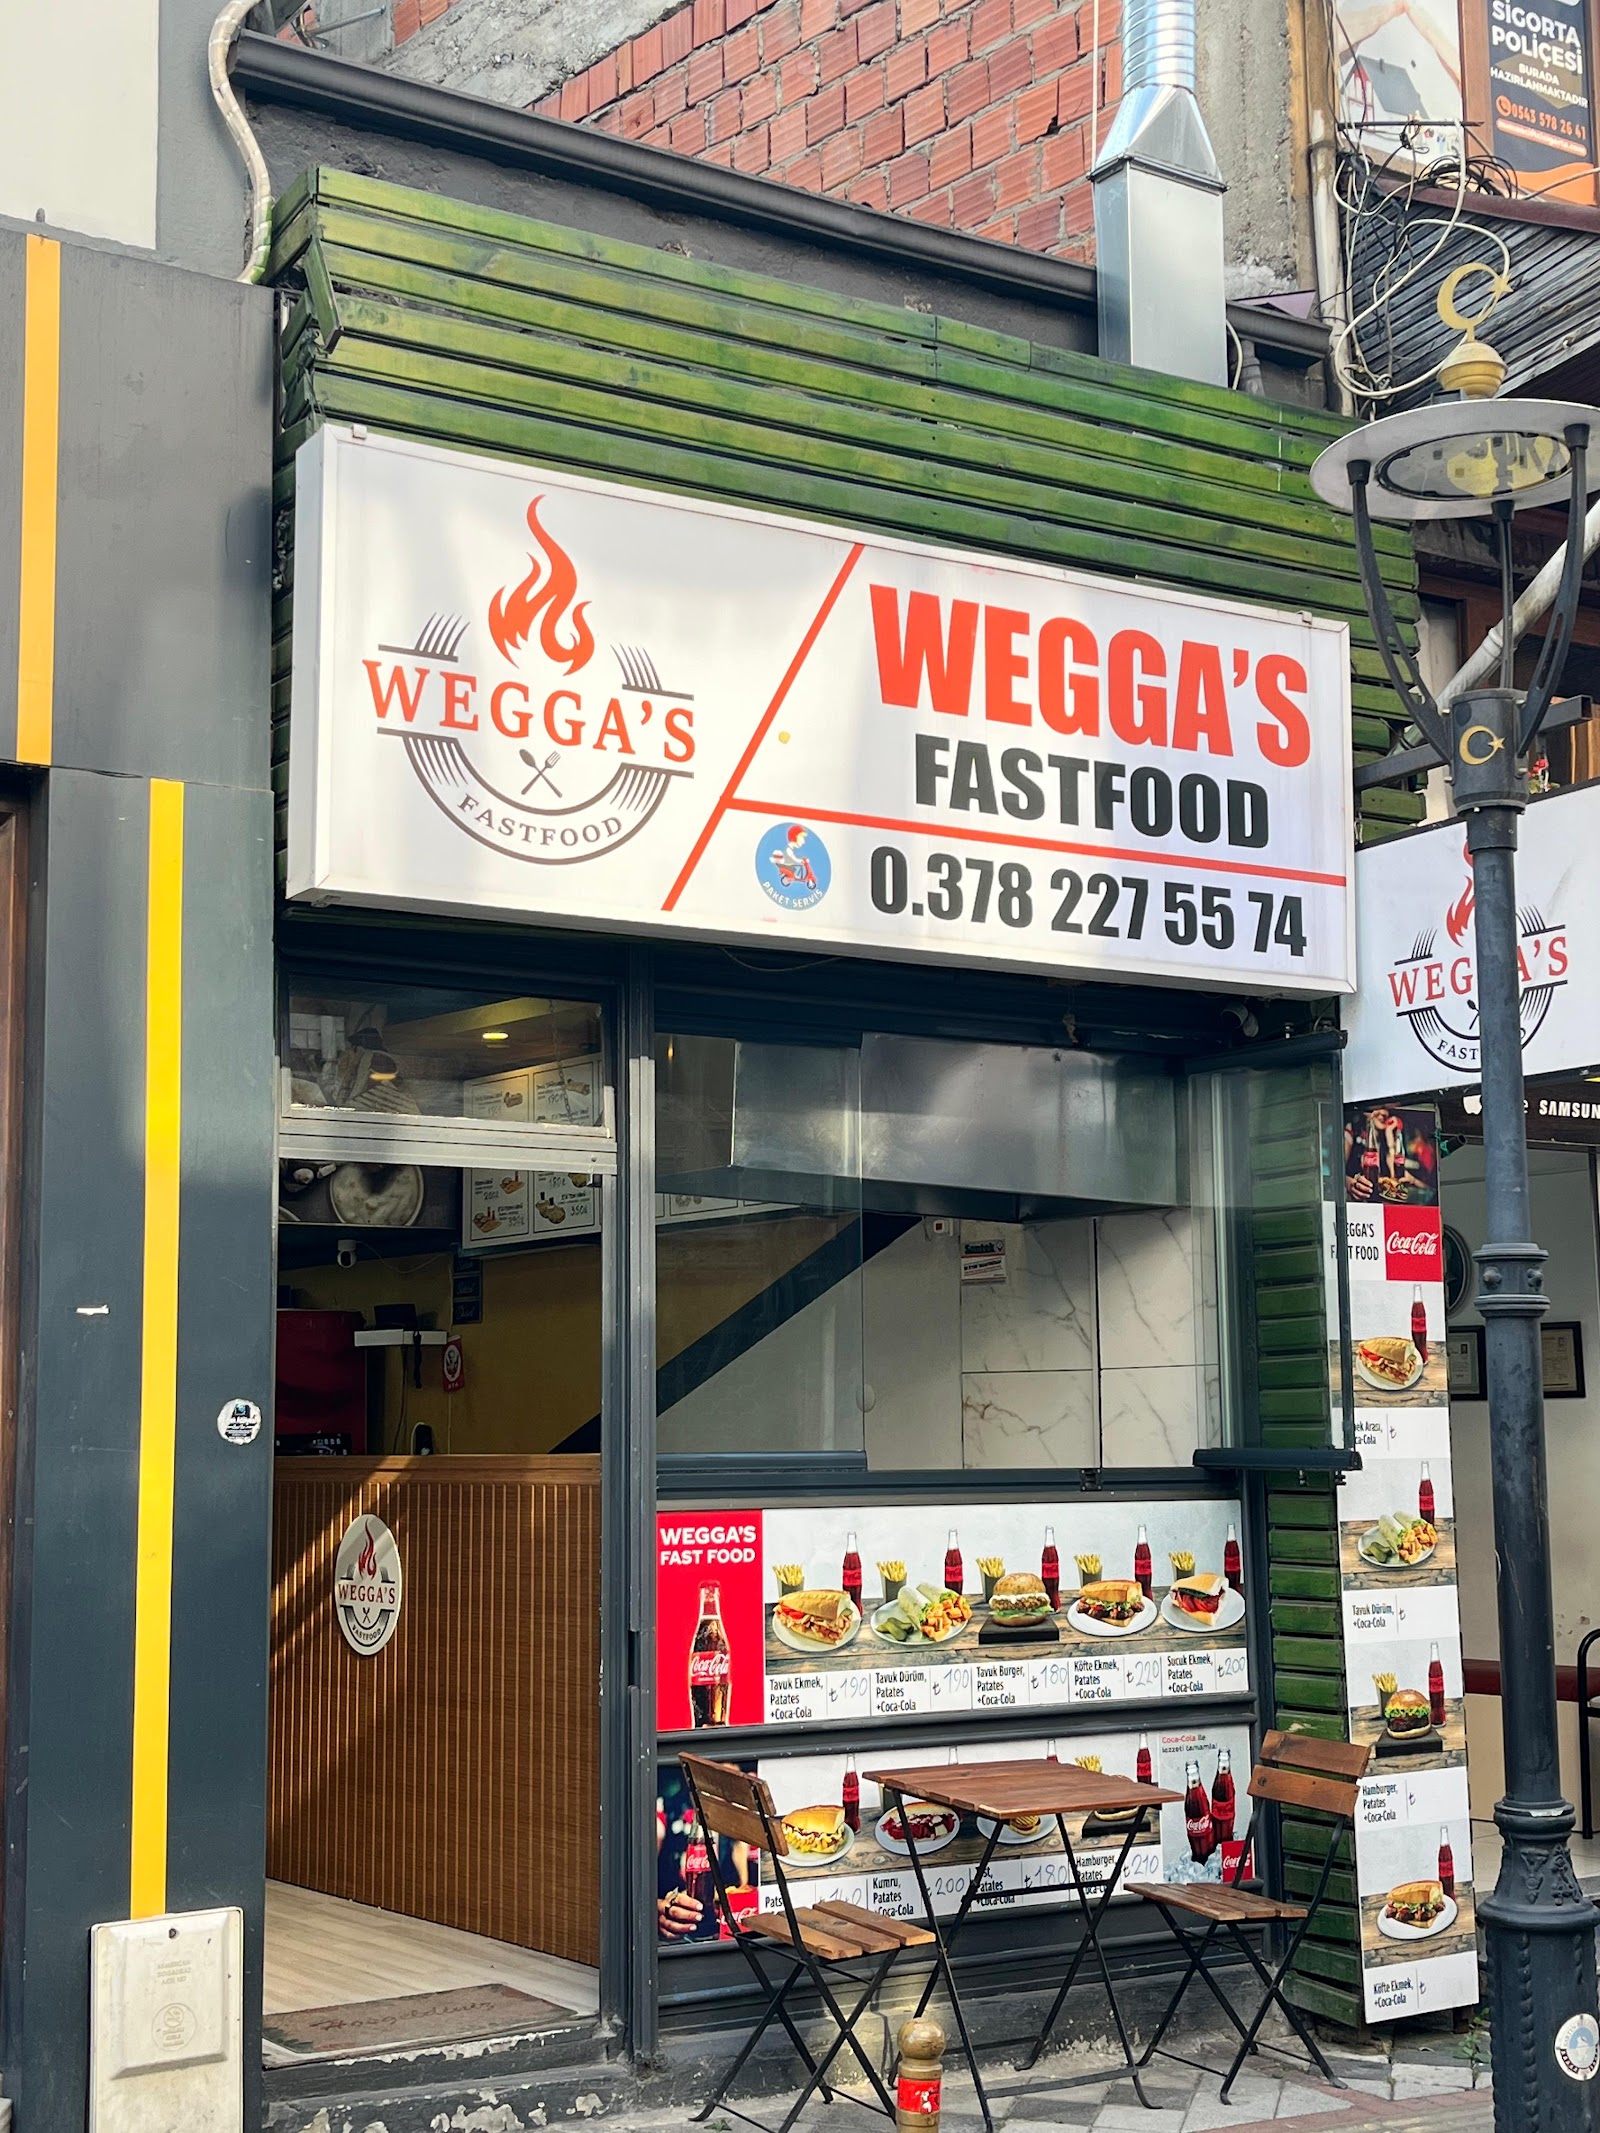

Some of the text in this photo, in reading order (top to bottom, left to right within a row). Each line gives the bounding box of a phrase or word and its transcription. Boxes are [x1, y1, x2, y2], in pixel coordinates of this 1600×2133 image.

[1492, 0, 1581, 48] SİGORTA
[1491, 25, 1583, 74] POLİÇESİ
[1518, 63, 1560, 85] BURADA
[1490, 66, 1588, 109] HAZIRLANMAKTADIR
[1511, 104, 1536, 123] 0543
[1560, 119, 1573, 136] 26
[868, 583, 1311, 768] WEGGA'S
[362, 658, 696, 764] WEGGA'S
[914, 733, 1269, 849] FASTFOOD
[457, 792, 623, 847] FASTFOOD
[762, 881, 790, 906] PAKET
[870, 845, 1307, 957] 0.378 227 55 74
[1388, 936, 1568, 1008] WEGA'S
[1330, 1244, 1379, 1260] FT FOOD
[1386, 1231, 1439, 1256] Coca-Cola
[660, 1525, 757, 1546] WEGGA'S
[660, 1548, 756, 1566] FAST FOOD
[338, 1584, 396, 1605] WEGGA'S
[1352, 1603, 1371, 1616] Tavuk
[691, 1653, 730, 1677] Coca-Cola
[1074, 1660, 1093, 1672] Köfte
[1094, 1658, 1120, 1671] Ekmek,
[1134, 1659, 1160, 1687] 220
[1167, 1655, 1187, 1667] Sucuk
[1188, 1653, 1213, 1666] Ekmek,
[1224, 1656, 1246, 1676] 200
[1168, 1669, 1193, 1680] Patates
[875, 1671, 898, 1684] Tavuk
[899, 1670, 927, 1684] Dürüm,
[943, 1668, 970, 1693] 190
[976, 1665, 998, 1678] Tavuk
[999, 1665, 1025, 1679] Burger,
[1041, 1663, 1068, 1688] 180
[977, 1680, 1004, 1692] Patates
[1074, 1675, 1101, 1686] Patates
[769, 1678, 793, 1691] Tavuk
[794, 1676, 824, 1690] Ekmek,
[840, 1676, 868, 1699] 190
[876, 1686, 904, 1698] Patates
[1075, 1687, 1112, 1700] +Coca-Cola
[1168, 1681, 1204, 1693] +Coca-Cola
[770, 1694, 800, 1706] Patates
[877, 1699, 917, 1713] +Coca-Cola
[977, 1692, 1016, 1706] +Coca-Cola
[770, 1707, 812, 1720] +Coca-Cola
[1162, 1734, 1196, 1744] Coca-Cola
[1362, 1783, 1398, 1796] Hamburger,
[1363, 1798, 1386, 1810] Patates
[1363, 1809, 1397, 1823] +Coca-Cola
[1034, 1864, 1068, 1886] 180
[1076, 1854, 1117, 1868] Hamburger,
[1131, 1853, 1160, 1876] 210
[872, 1877, 901, 1889] Kumru,
[935, 1877, 965, 1896] 200
[979, 1880, 1003, 1892] atates
[765, 1896, 785, 1908] Pats
[872, 1891, 902, 1904] Patates
[1374, 1992, 1407, 2008] +Coca-Cola
